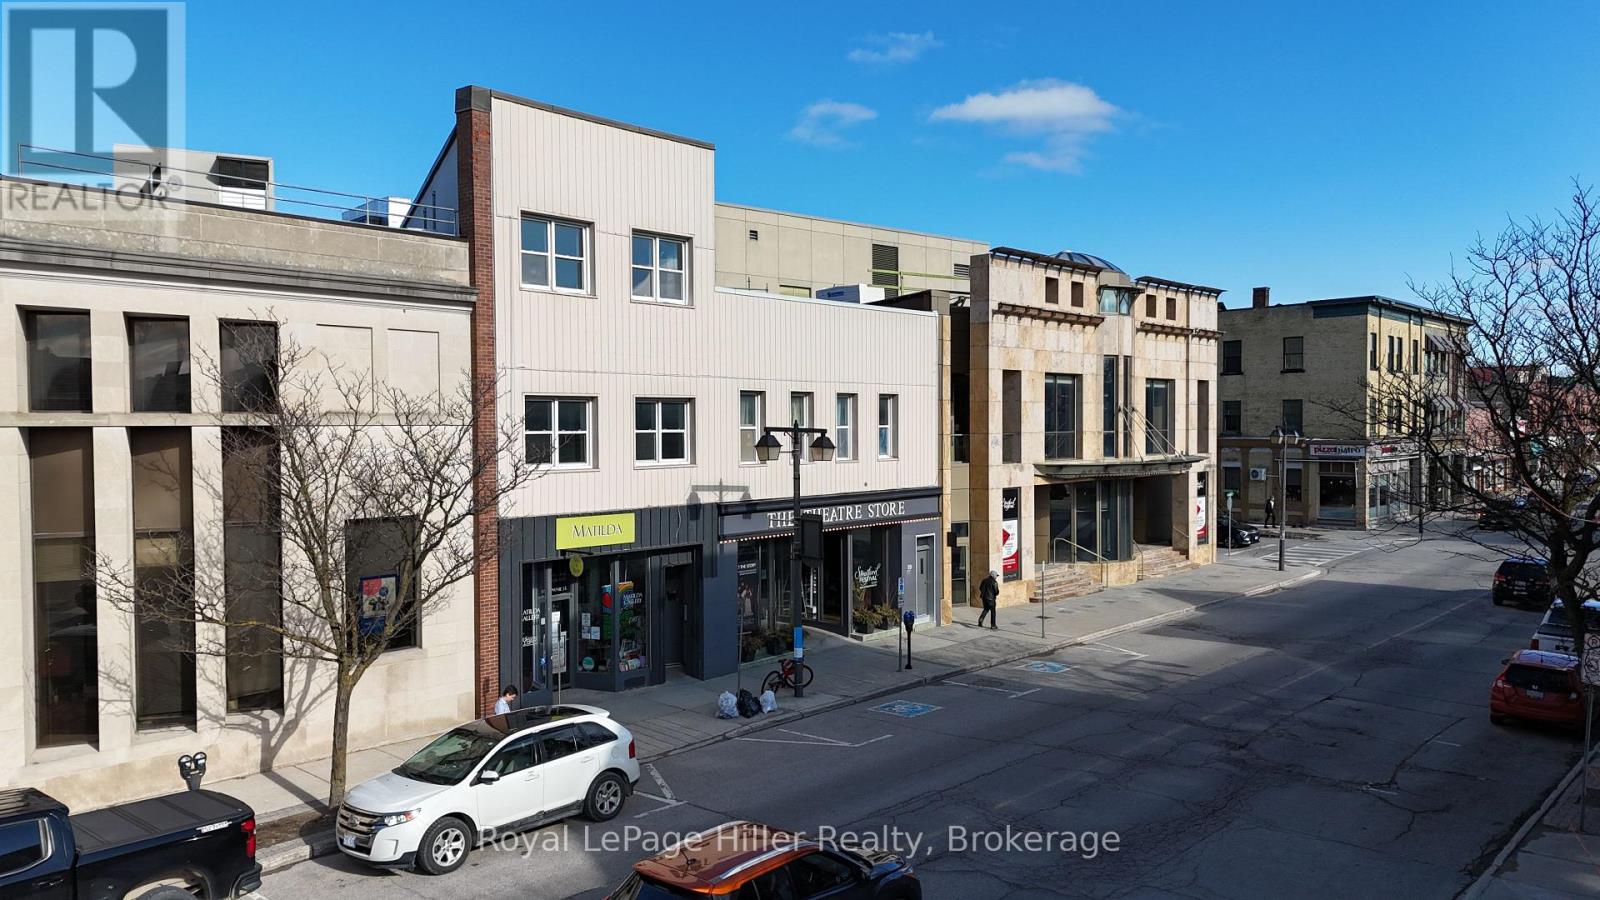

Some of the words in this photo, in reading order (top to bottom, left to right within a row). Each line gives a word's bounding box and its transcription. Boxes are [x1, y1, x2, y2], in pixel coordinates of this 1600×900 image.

[767, 511, 795, 529] THE
[868, 501, 906, 518] STORE
[573, 524, 622, 538] MATILDA
